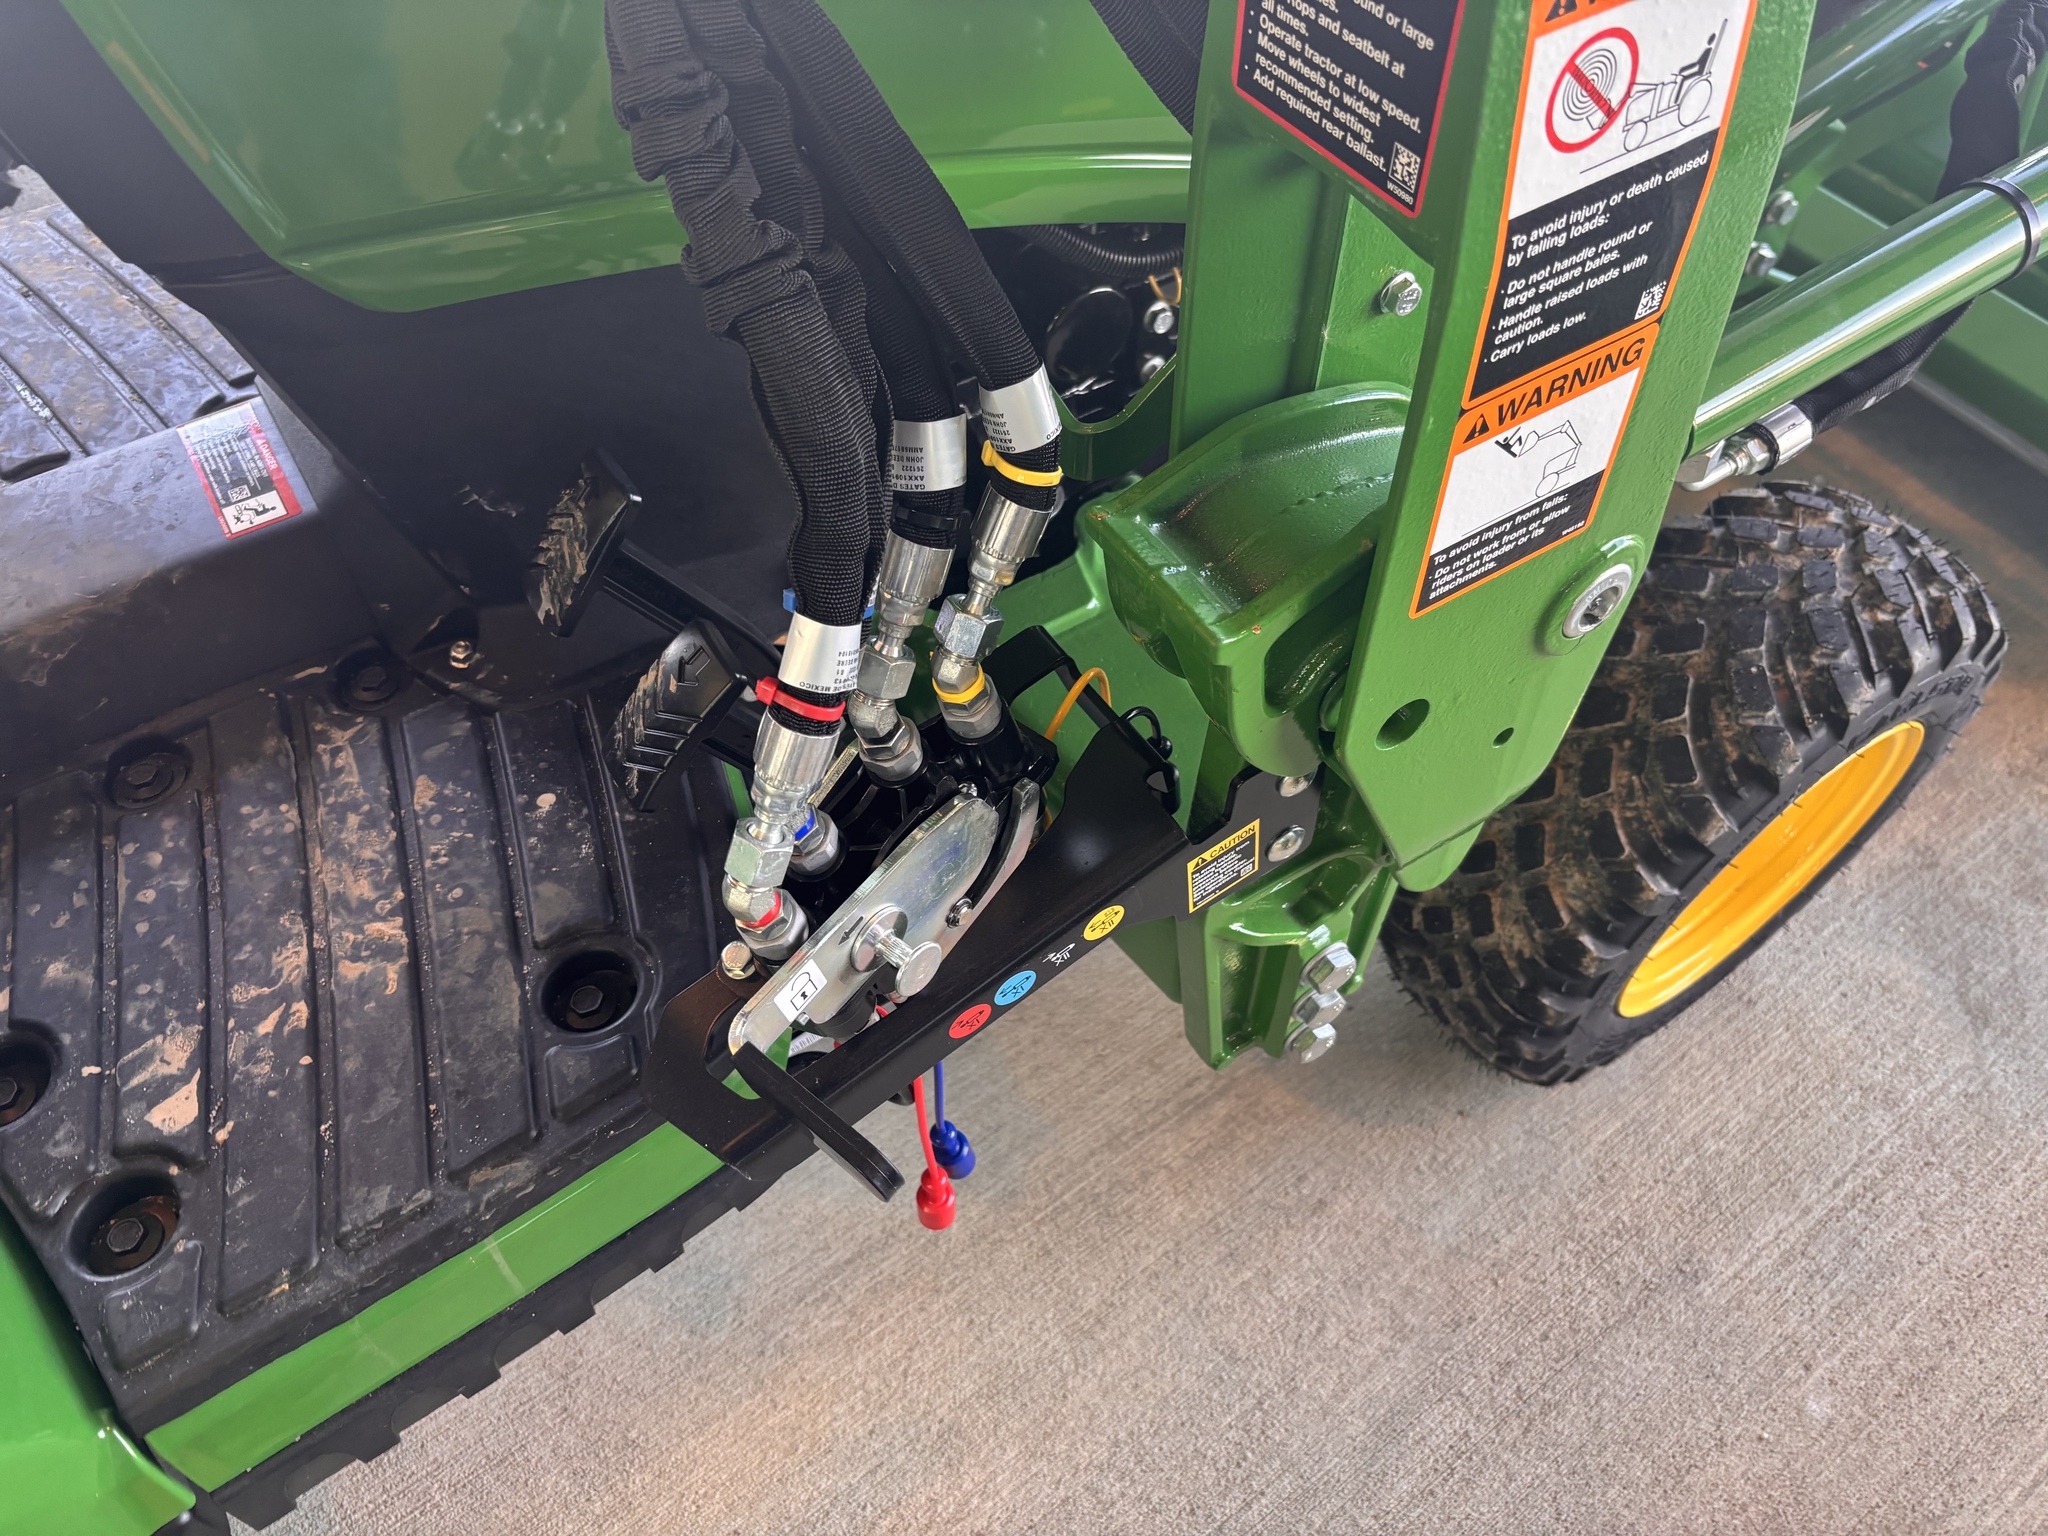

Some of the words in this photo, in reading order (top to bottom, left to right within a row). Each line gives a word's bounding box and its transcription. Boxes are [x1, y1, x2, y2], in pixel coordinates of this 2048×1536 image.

[1261, 0, 1274, 13] all
[1276, 4, 1308, 36] times.
[1317, 13, 1340, 35] and
[1341, 28, 1390, 68] seatbelt
[1391, 61, 1405, 78] at
[1386, 10, 1401, 28] or
[1402, 18, 1435, 51] large
[1255, 52, 1331, 112] recommended
[1332, 106, 1373, 143] setting.
[1257, 31, 1286, 61] Move
[1288, 55, 1326, 88] wheels
[1328, 80, 1340, 97] to
[1342, 92, 1380, 126] widest
[1259, 13, 1302, 51] Operate
[1304, 43, 1342, 78] tractor
[1344, 73, 1356, 89] at
[1358, 78, 1380, 103] low
[1381, 98, 1421, 133] speed.
[1253, 68, 1274, 92] Add
[1276, 86, 1320, 123] required
[1321, 118, 1345, 140] rear
[1346, 132, 1386, 172] ballast.
[1387, 180, 1413, 205] W50980
[1511, 234, 1527, 249] To
[1529, 213, 1567, 241] avoid
[1569, 199, 1607, 224] injury
[1609, 191, 1624, 206] or
[1626, 173, 1662, 198] death
[1665, 149, 1709, 181] caused
[1507, 251, 1524, 267] by
[1526, 232, 1567, 258] falling
[1570, 213, 1610, 238] loads:
[1507, 278, 1526, 294] Do
[1528, 265, 1550, 284] not
[1552, 246, 1596, 273] handle
[1598, 225, 1636, 253] round
[1638, 221, 1653, 234] or
[1498, 303, 1542, 330] Handle
[1544, 281, 1584, 309] raised
[1585, 268, 1620, 290] loads
[1622, 254, 1648, 273] with
[1503, 287, 1536, 309] large
[1538, 266, 1582, 293] square
[1584, 249, 1620, 272] bales.
[1490, 340, 1524, 362] Carry
[1526, 323, 1560, 345] loads
[1562, 312, 1586, 329] low.
[1494, 316, 1543, 344] caution.
[1498, 337, 1645, 426] WARNING
[258, 442, 278, 470] DANGER
[891, 473, 925, 482] AXX1091
[1431, 568, 1463, 589] riders
[1465, 559, 1480, 571] on
[1482, 541, 1516, 563] loader
[1517, 534, 1530, 545] or
[1531, 527, 1544, 538] its
[1433, 554, 1446, 565] To
[1448, 535, 1480, 557] avoid
[1481, 520, 1513, 541] injury
[1514, 507, 1540, 524] from
[1541, 493, 1568, 511] falls:
[1434, 566, 1450, 578] Do
[1452, 553, 1471, 569] not
[1473, 540, 1500, 558] work
[1501, 527, 1527, 544] from
[1528, 519, 1541, 530] or
[1541, 505, 1570, 524] allow
[1428, 561, 1497, 599] attachments.
[799, 681, 831, 692] MEXICO
[1210, 825, 1254, 859] CAUTION
